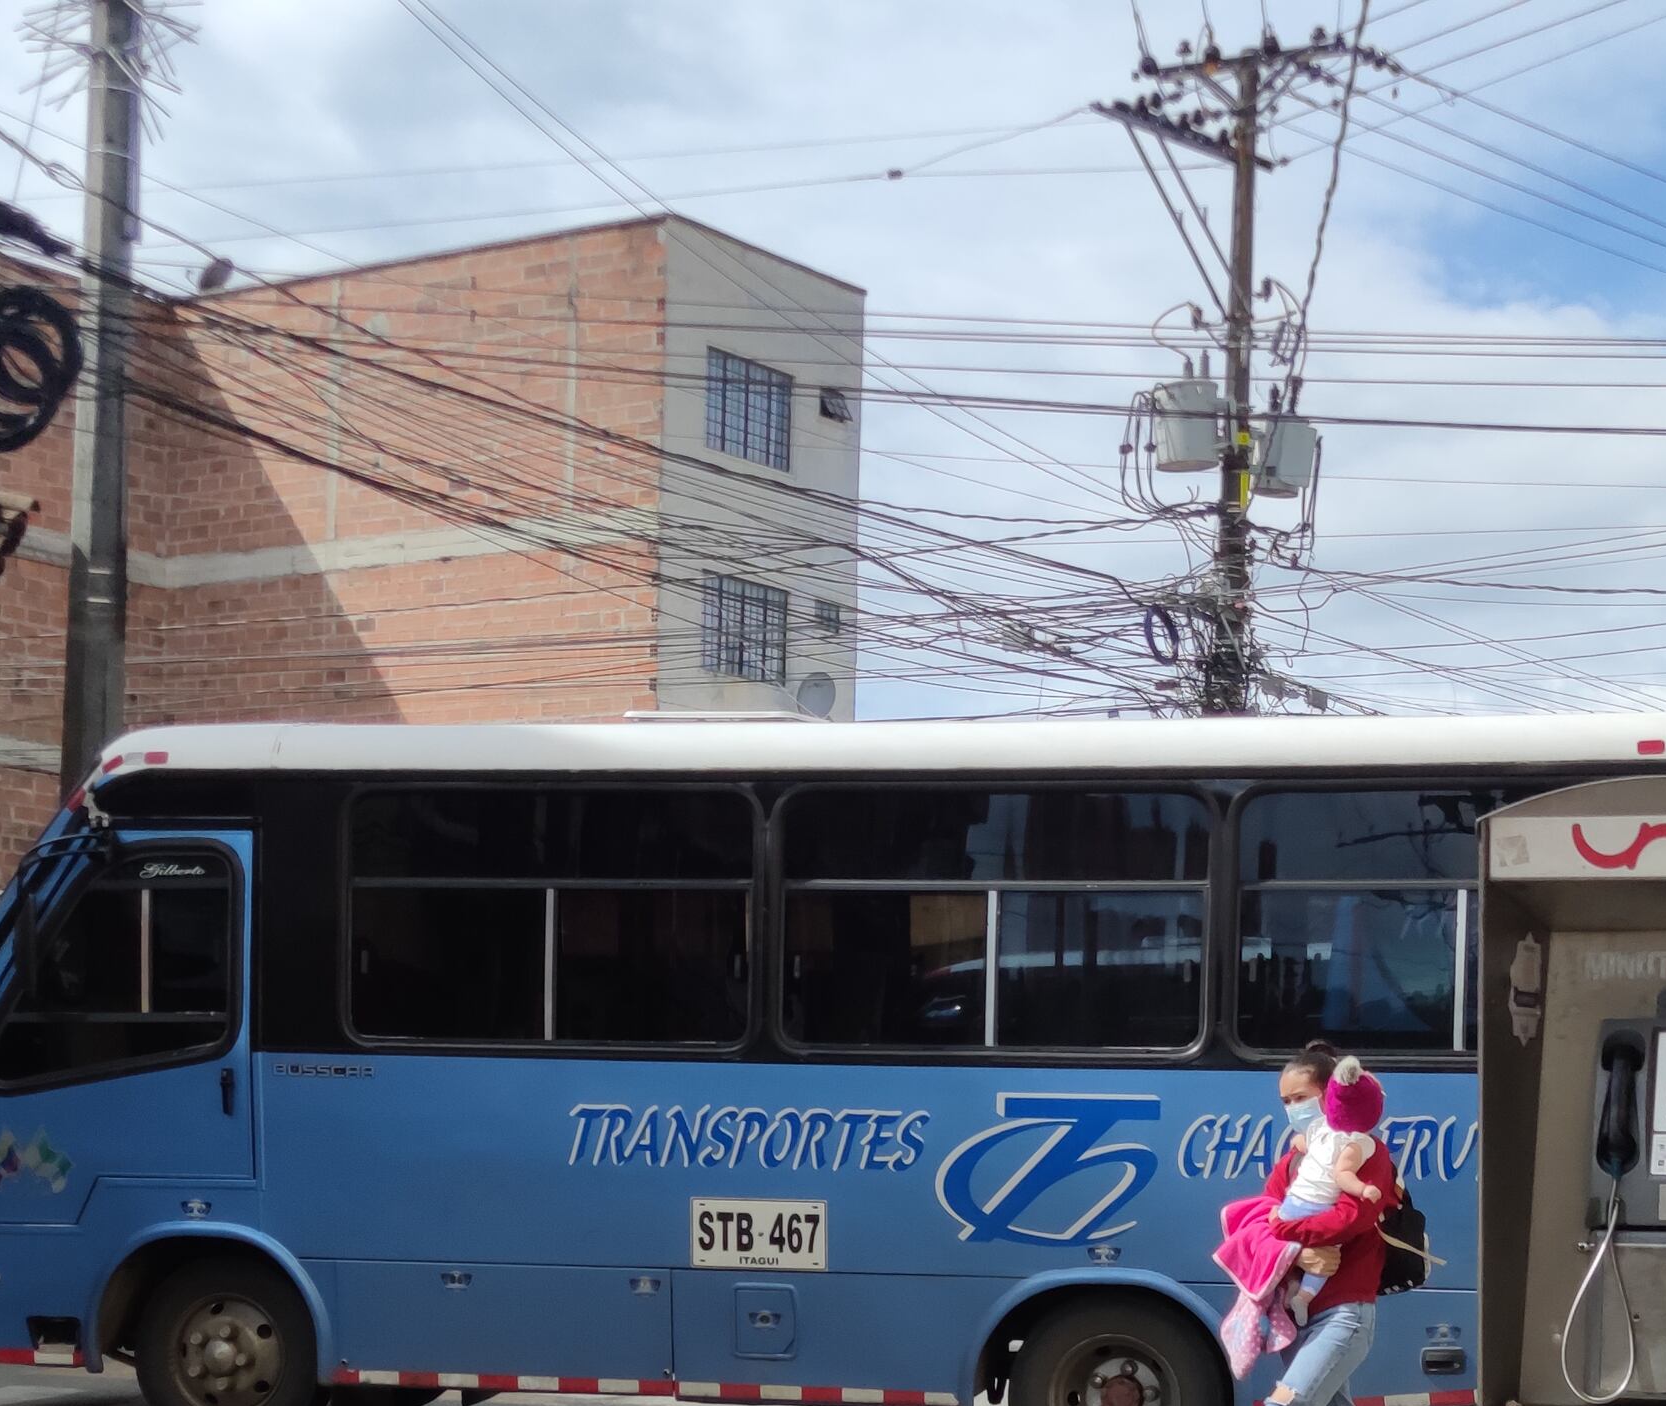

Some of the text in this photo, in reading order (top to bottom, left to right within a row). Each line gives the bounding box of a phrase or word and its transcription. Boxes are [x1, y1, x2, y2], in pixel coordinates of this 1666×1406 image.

[139, 862, 206, 879] Gilberto
[569, 1103, 931, 1172] TRANSPORTES
[739, 1256, 780, 1266] ITAGUI
